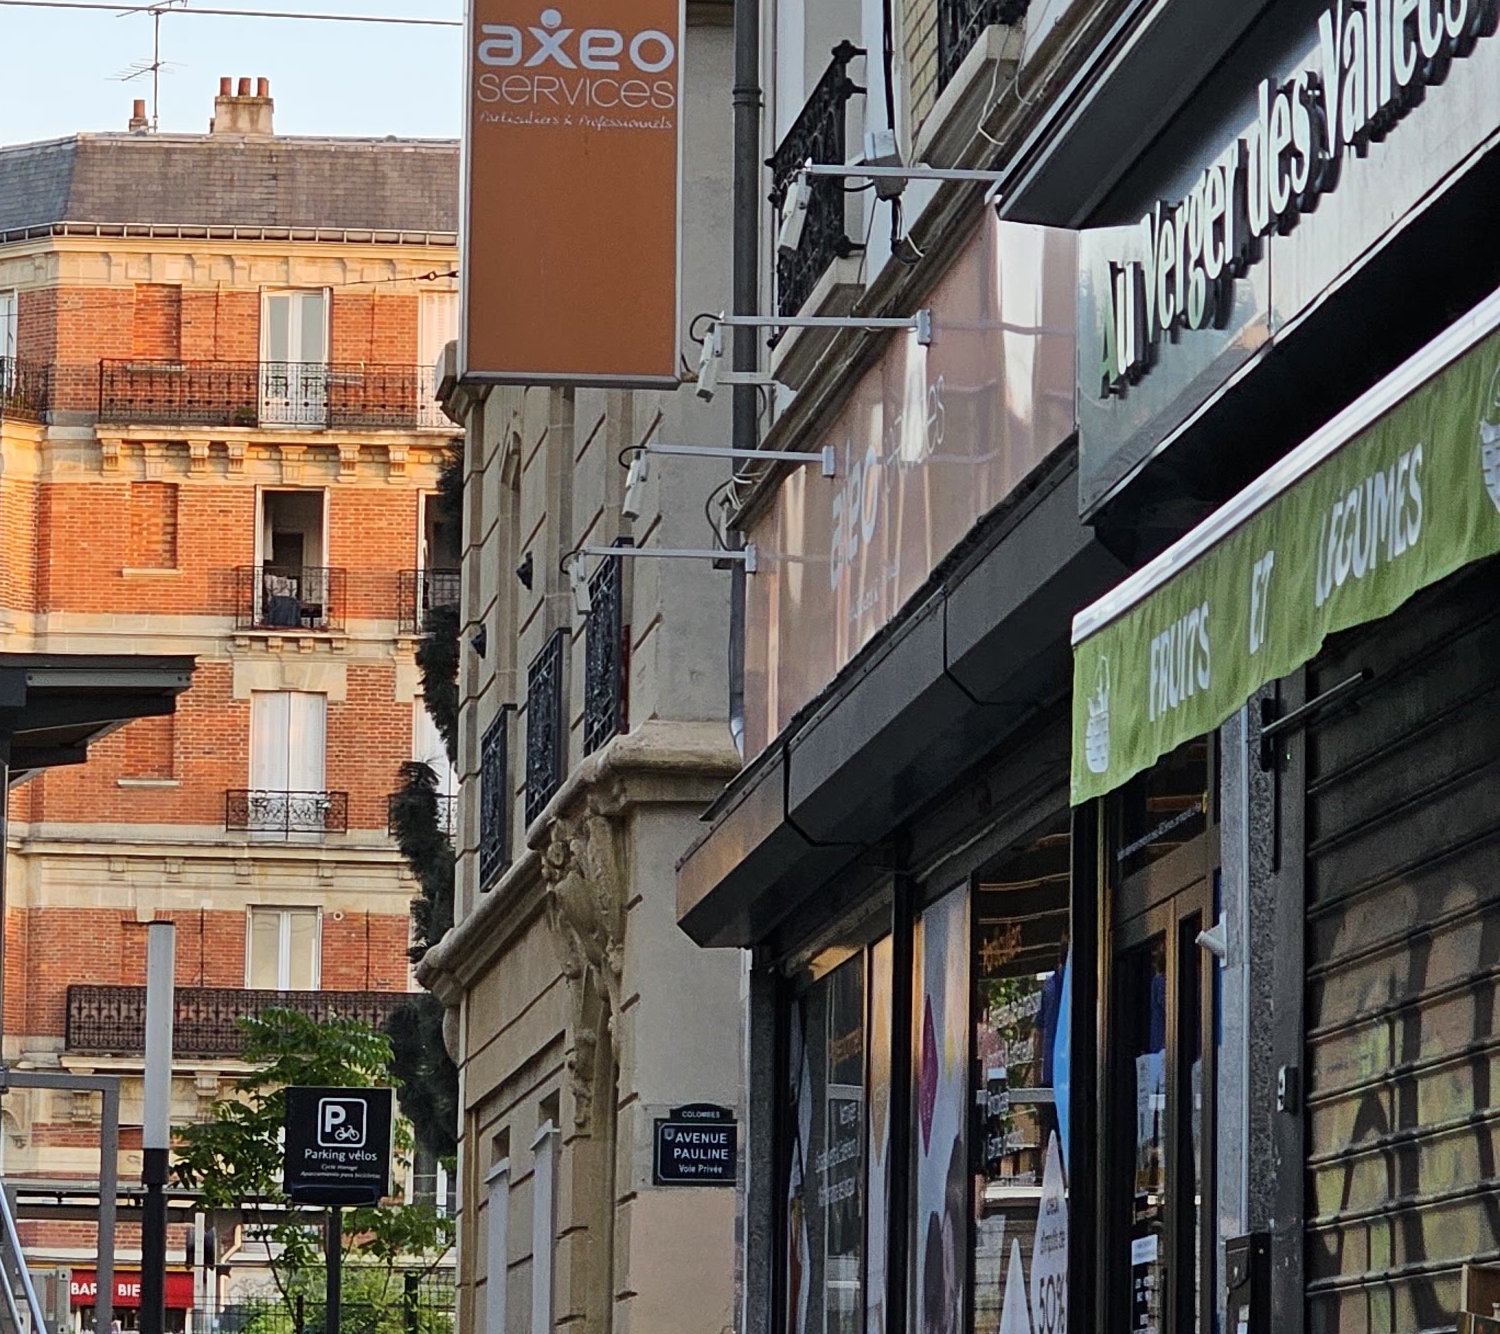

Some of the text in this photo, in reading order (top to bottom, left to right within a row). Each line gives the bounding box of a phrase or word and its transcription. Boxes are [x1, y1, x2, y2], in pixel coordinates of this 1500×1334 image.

[478, 9, 675, 73] axeo
[1141, 154, 1237, 344] Verger
[1247, 70, 1311, 237] des
[1148, 600, 1211, 723] FRUITS
[1249, 550, 1274, 655] ET
[324, 1104, 346, 1133] P
[681, 1110, 720, 1119] COLOMBES
[675, 1132, 728, 1144] AVENUE
[304, 1148, 378, 1162] Parking vélos
[673, 1148, 729, 1160] PAULINE
[678, 1164, 723, 1174] Voie Privée
[117, 1283, 141, 1298] BIE
